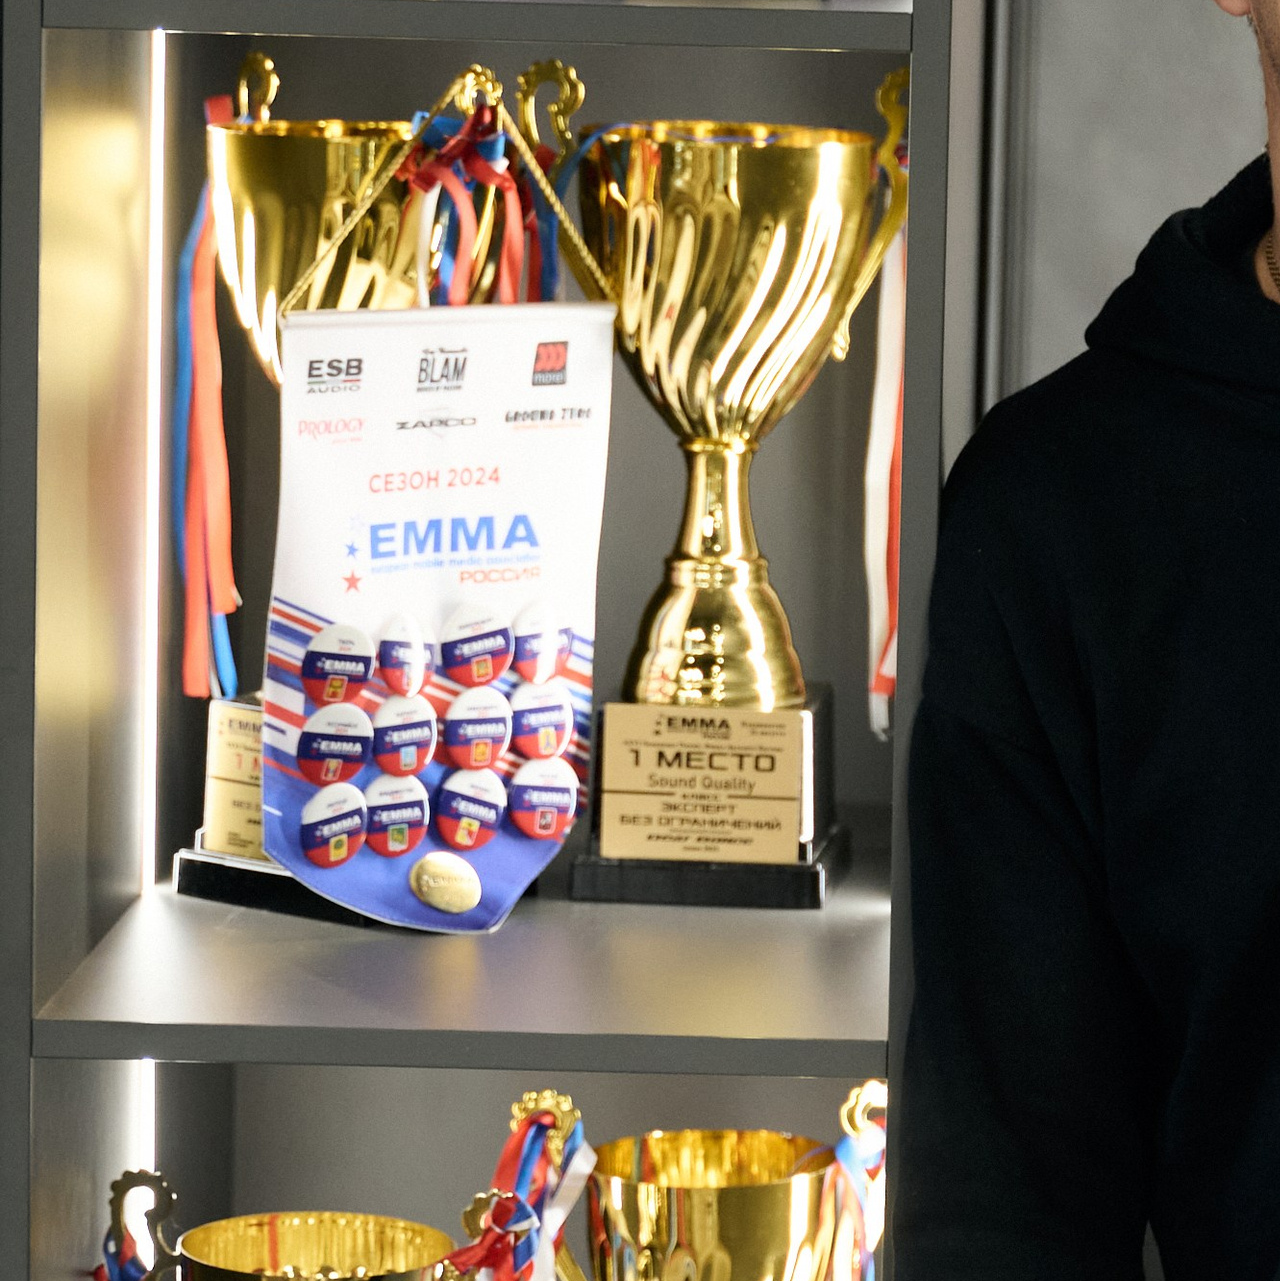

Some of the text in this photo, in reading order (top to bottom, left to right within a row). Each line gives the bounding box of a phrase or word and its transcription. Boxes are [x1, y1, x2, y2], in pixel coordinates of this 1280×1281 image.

[307, 358, 363, 378] ESB
[418, 356, 467, 384] BLAM
[307, 384, 361, 394] AUDIO
[298, 418, 365, 439] PROLOGY
[396, 417, 477, 430] ZAPCO
[369, 467, 500, 493] СЕЗОН 2024
[369, 514, 540, 559] EMMA
[460, 568, 541, 584] РОССИЯ
[325, 659, 365, 674] EMMA
[667, 718, 730, 728] EMMA
[320, 740, 363, 754] EMMA
[630, 749, 775, 772] 1 МЕСТО
[649, 774, 756, 793] Sound Quality
[381, 807, 423, 822] EMMA
[662, 802, 736, 814] ЭКСПЕРТ
[322, 815, 361, 835] EMMA
[619, 815, 782, 831] БЕЗ ОГРАНИЧЕНИЙ
